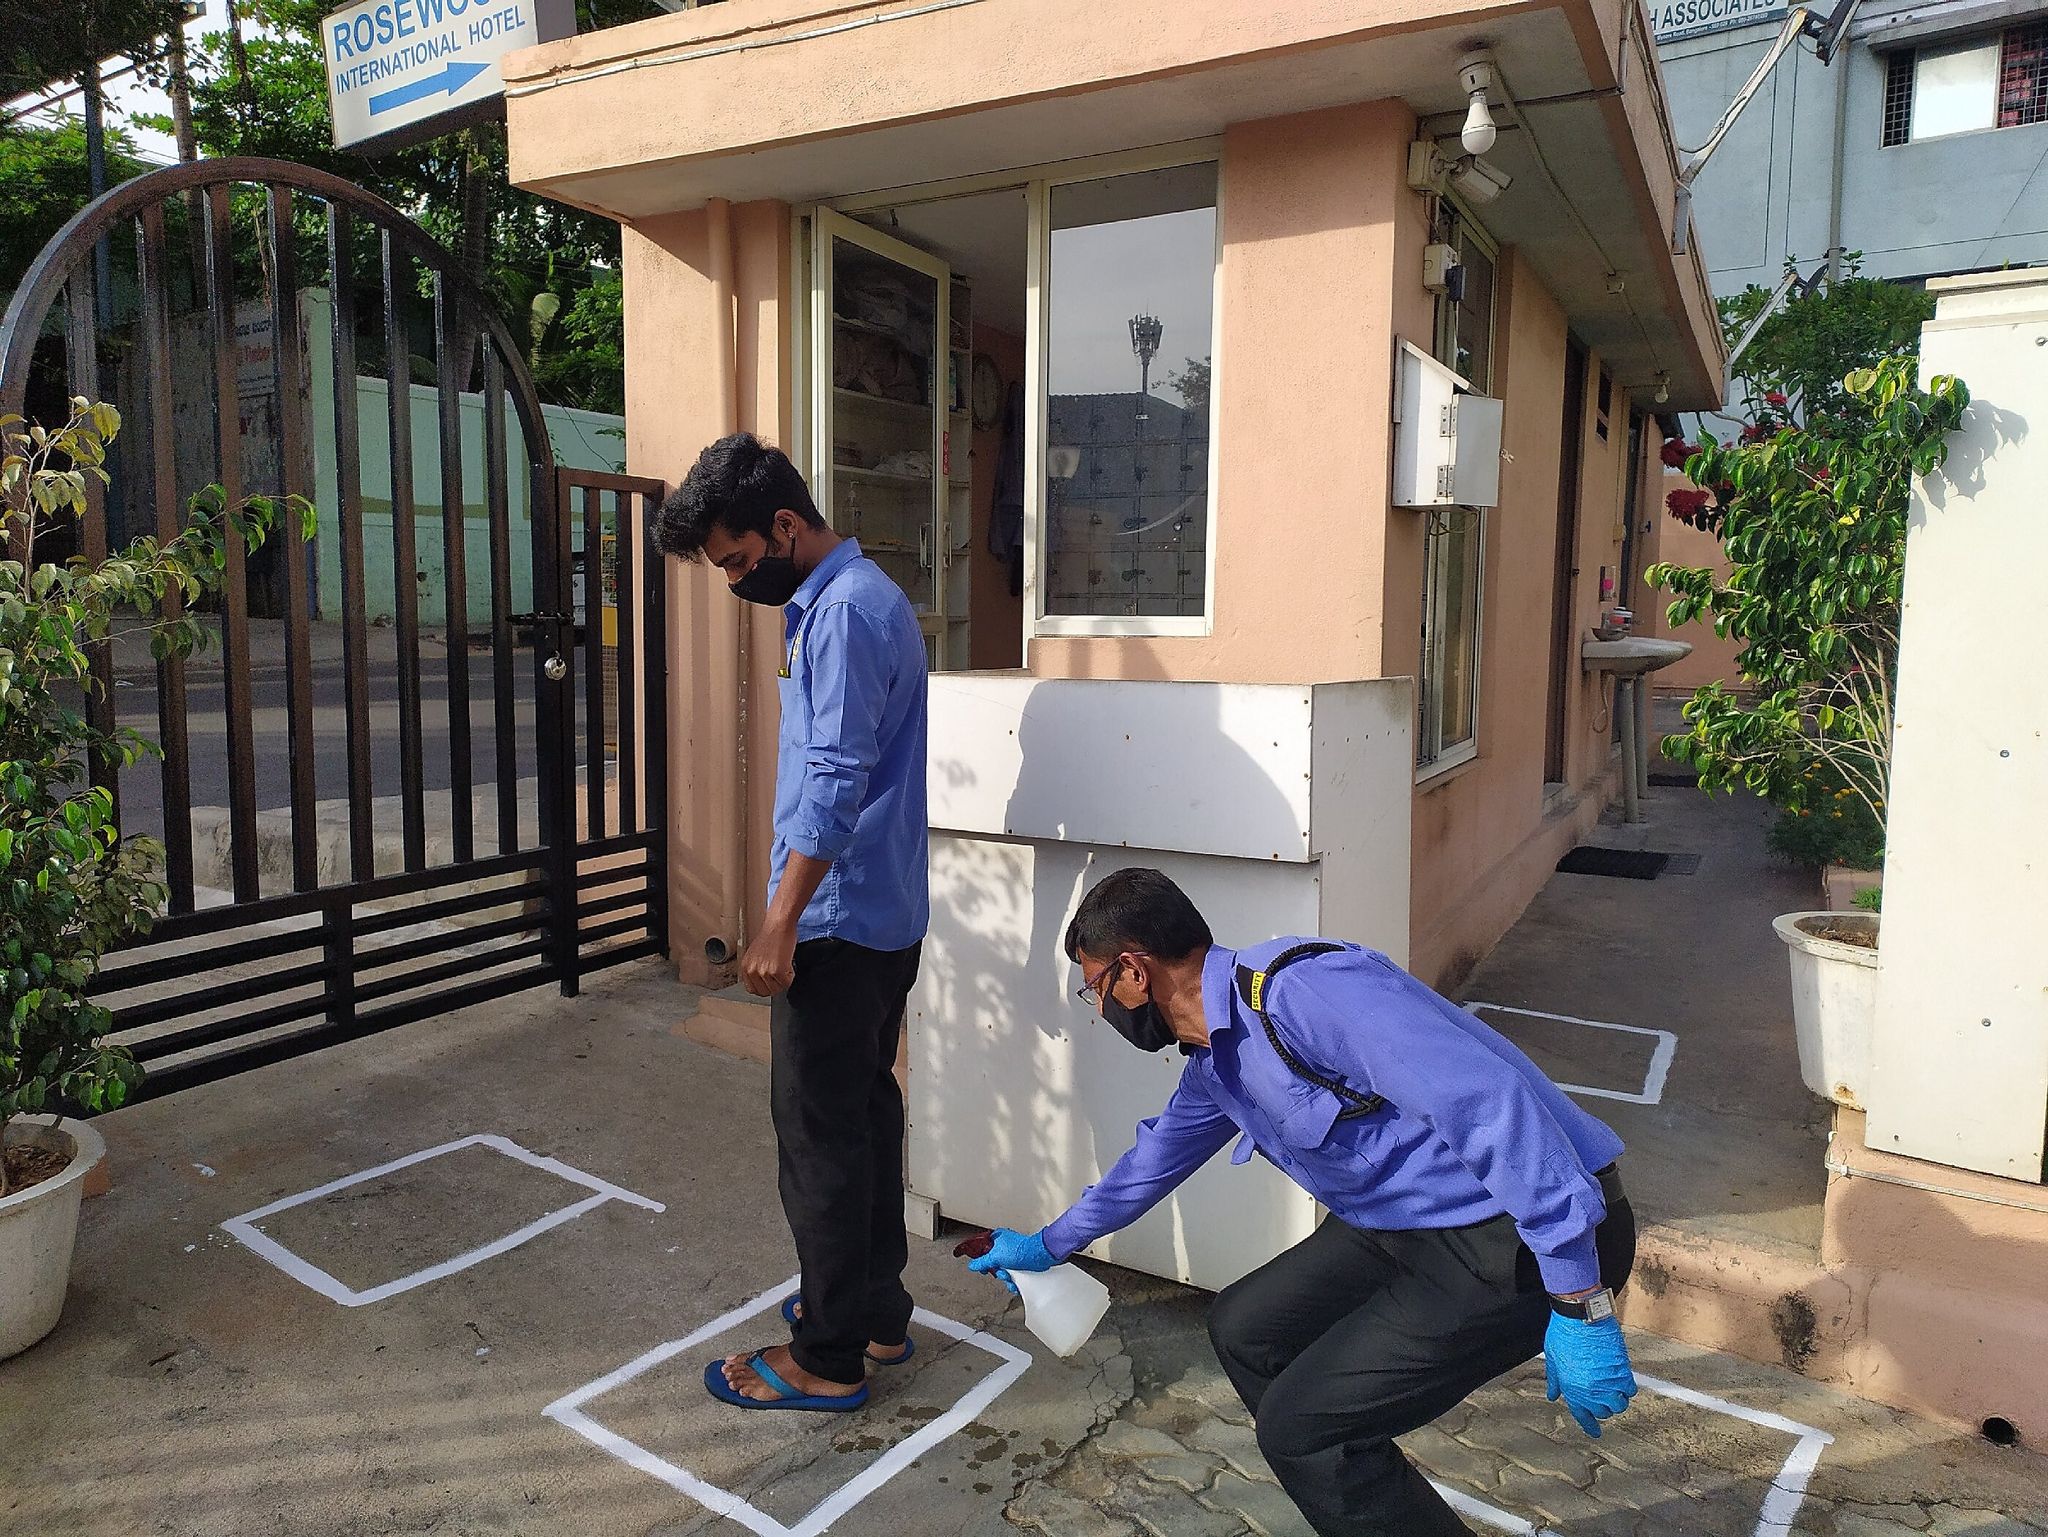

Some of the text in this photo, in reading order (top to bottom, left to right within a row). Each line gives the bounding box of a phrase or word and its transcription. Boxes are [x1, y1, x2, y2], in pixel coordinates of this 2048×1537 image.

[333, 0, 489, 62] ROSEW
[1662, 0, 1775, 28] ASSOCIA
[336, 5, 526, 95] INTERNATIONAL HOTEL
[1253, 973, 1262, 1008] SECURITY
